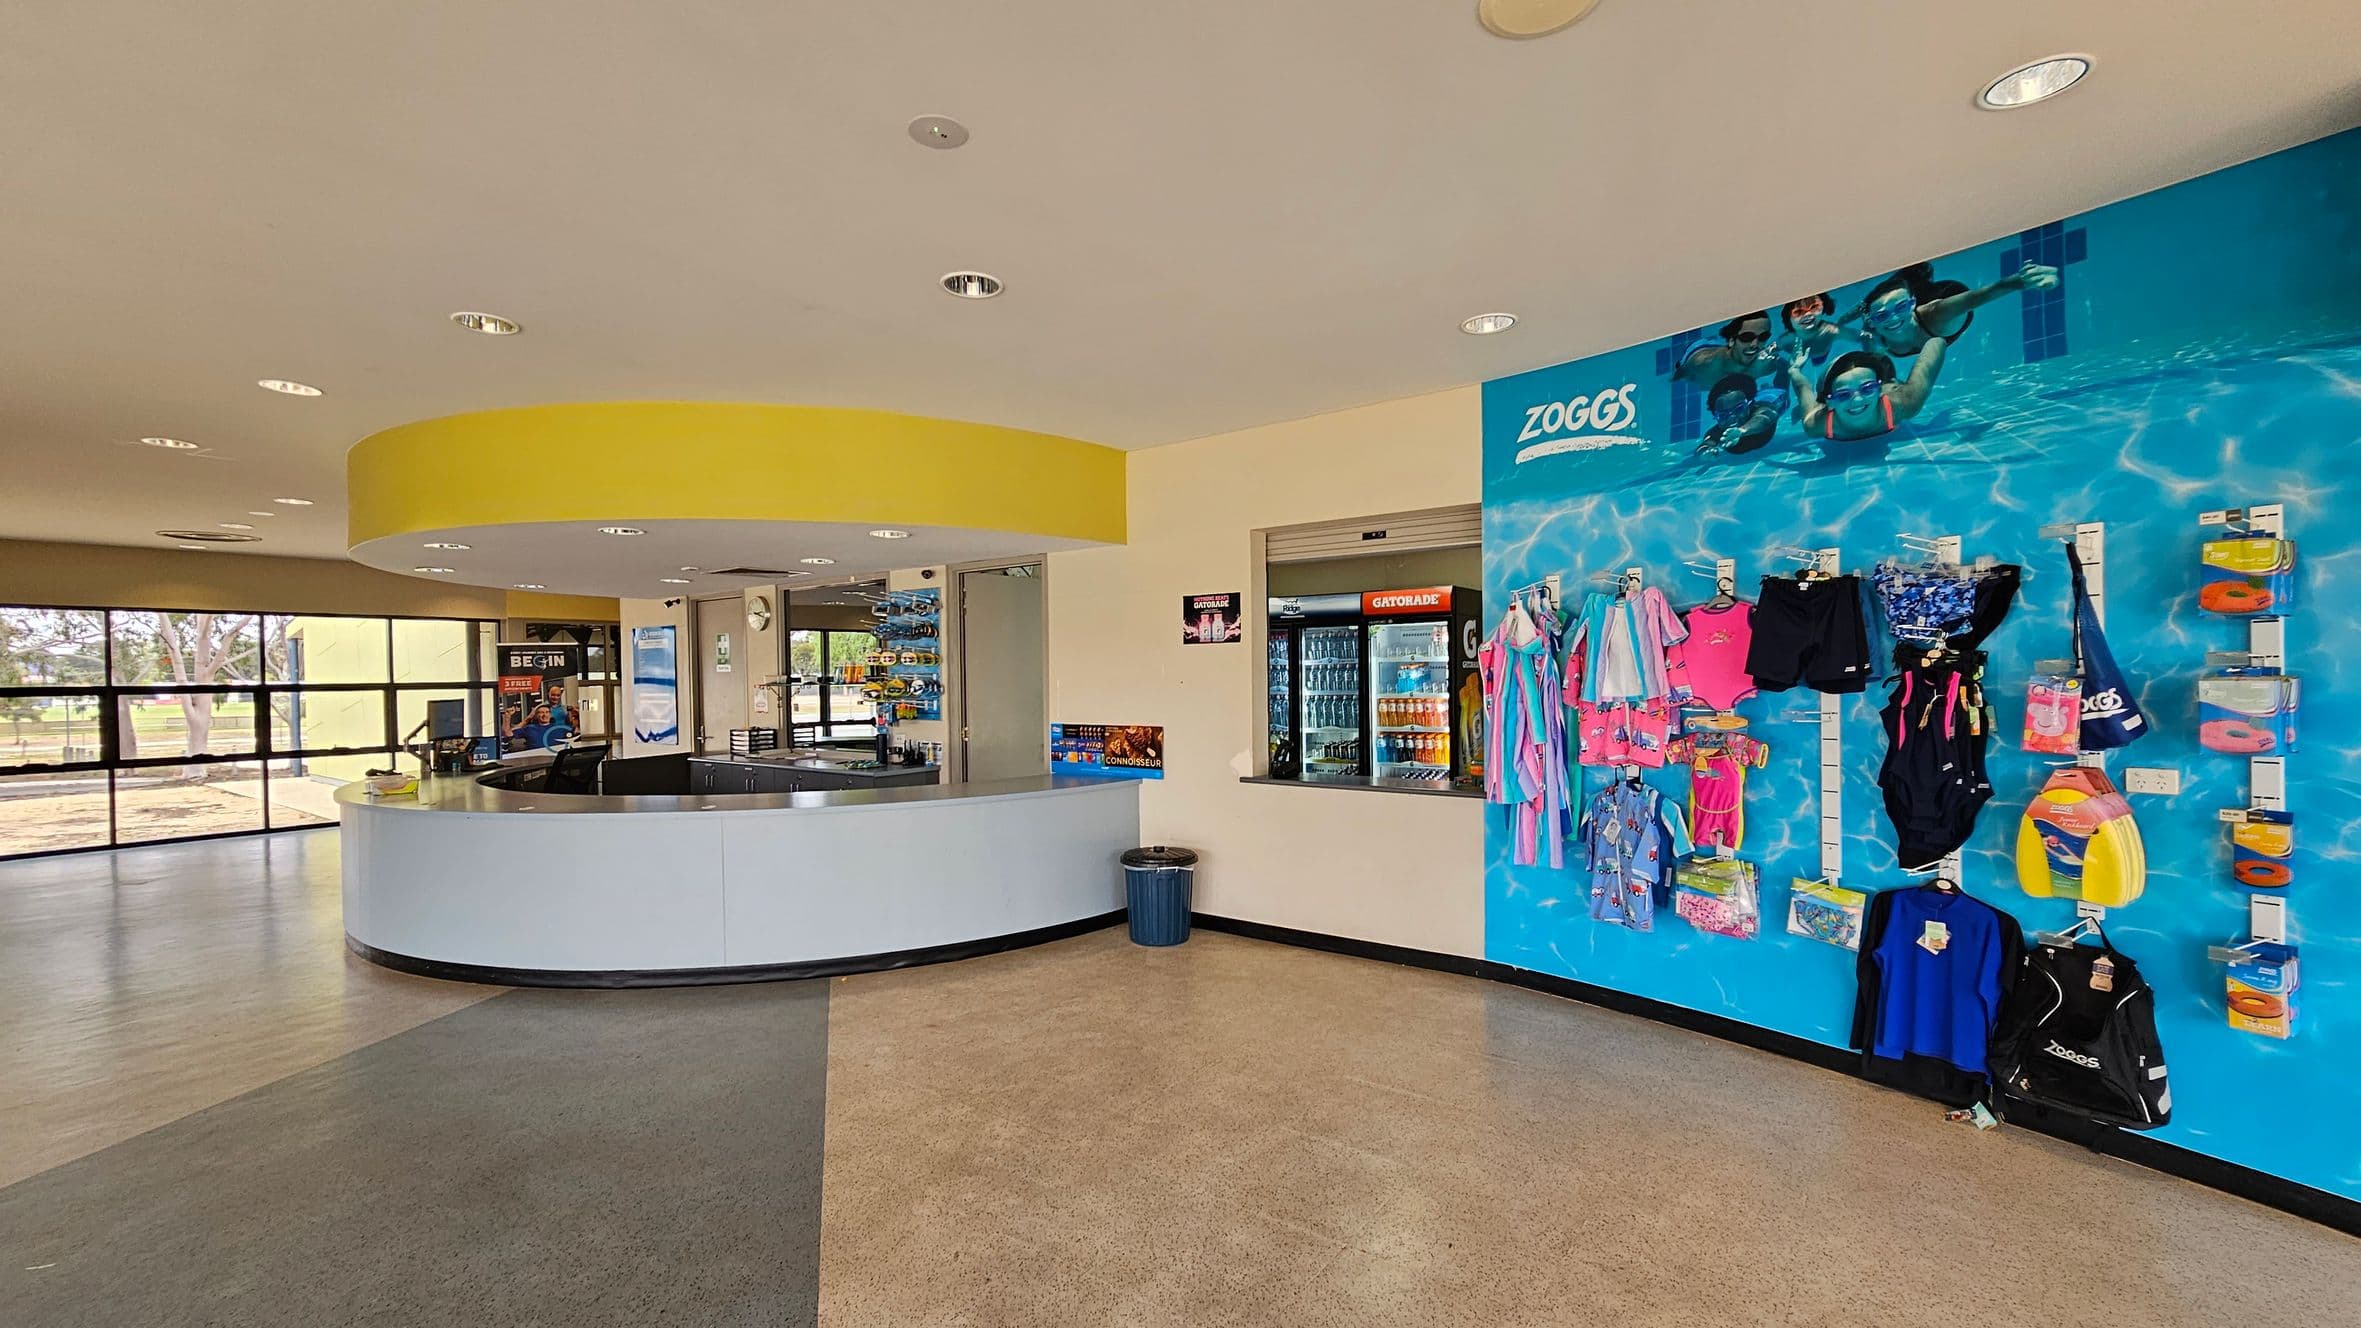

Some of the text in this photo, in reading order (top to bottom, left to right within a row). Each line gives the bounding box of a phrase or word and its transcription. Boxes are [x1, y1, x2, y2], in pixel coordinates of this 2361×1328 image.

[1516, 383, 1637, 443] ZOGGS
[1193, 600, 1230, 609] GATORADE
[1372, 593, 1440, 608] GATORADE
[1462, 619, 1477, 659] G
[510, 655, 565, 669] BEGIN
[2080, 688, 2123, 713] OGGS
[1105, 756, 1162, 768] CONNOISSEUR
[2044, 1039, 2102, 1070] ZOGGS
